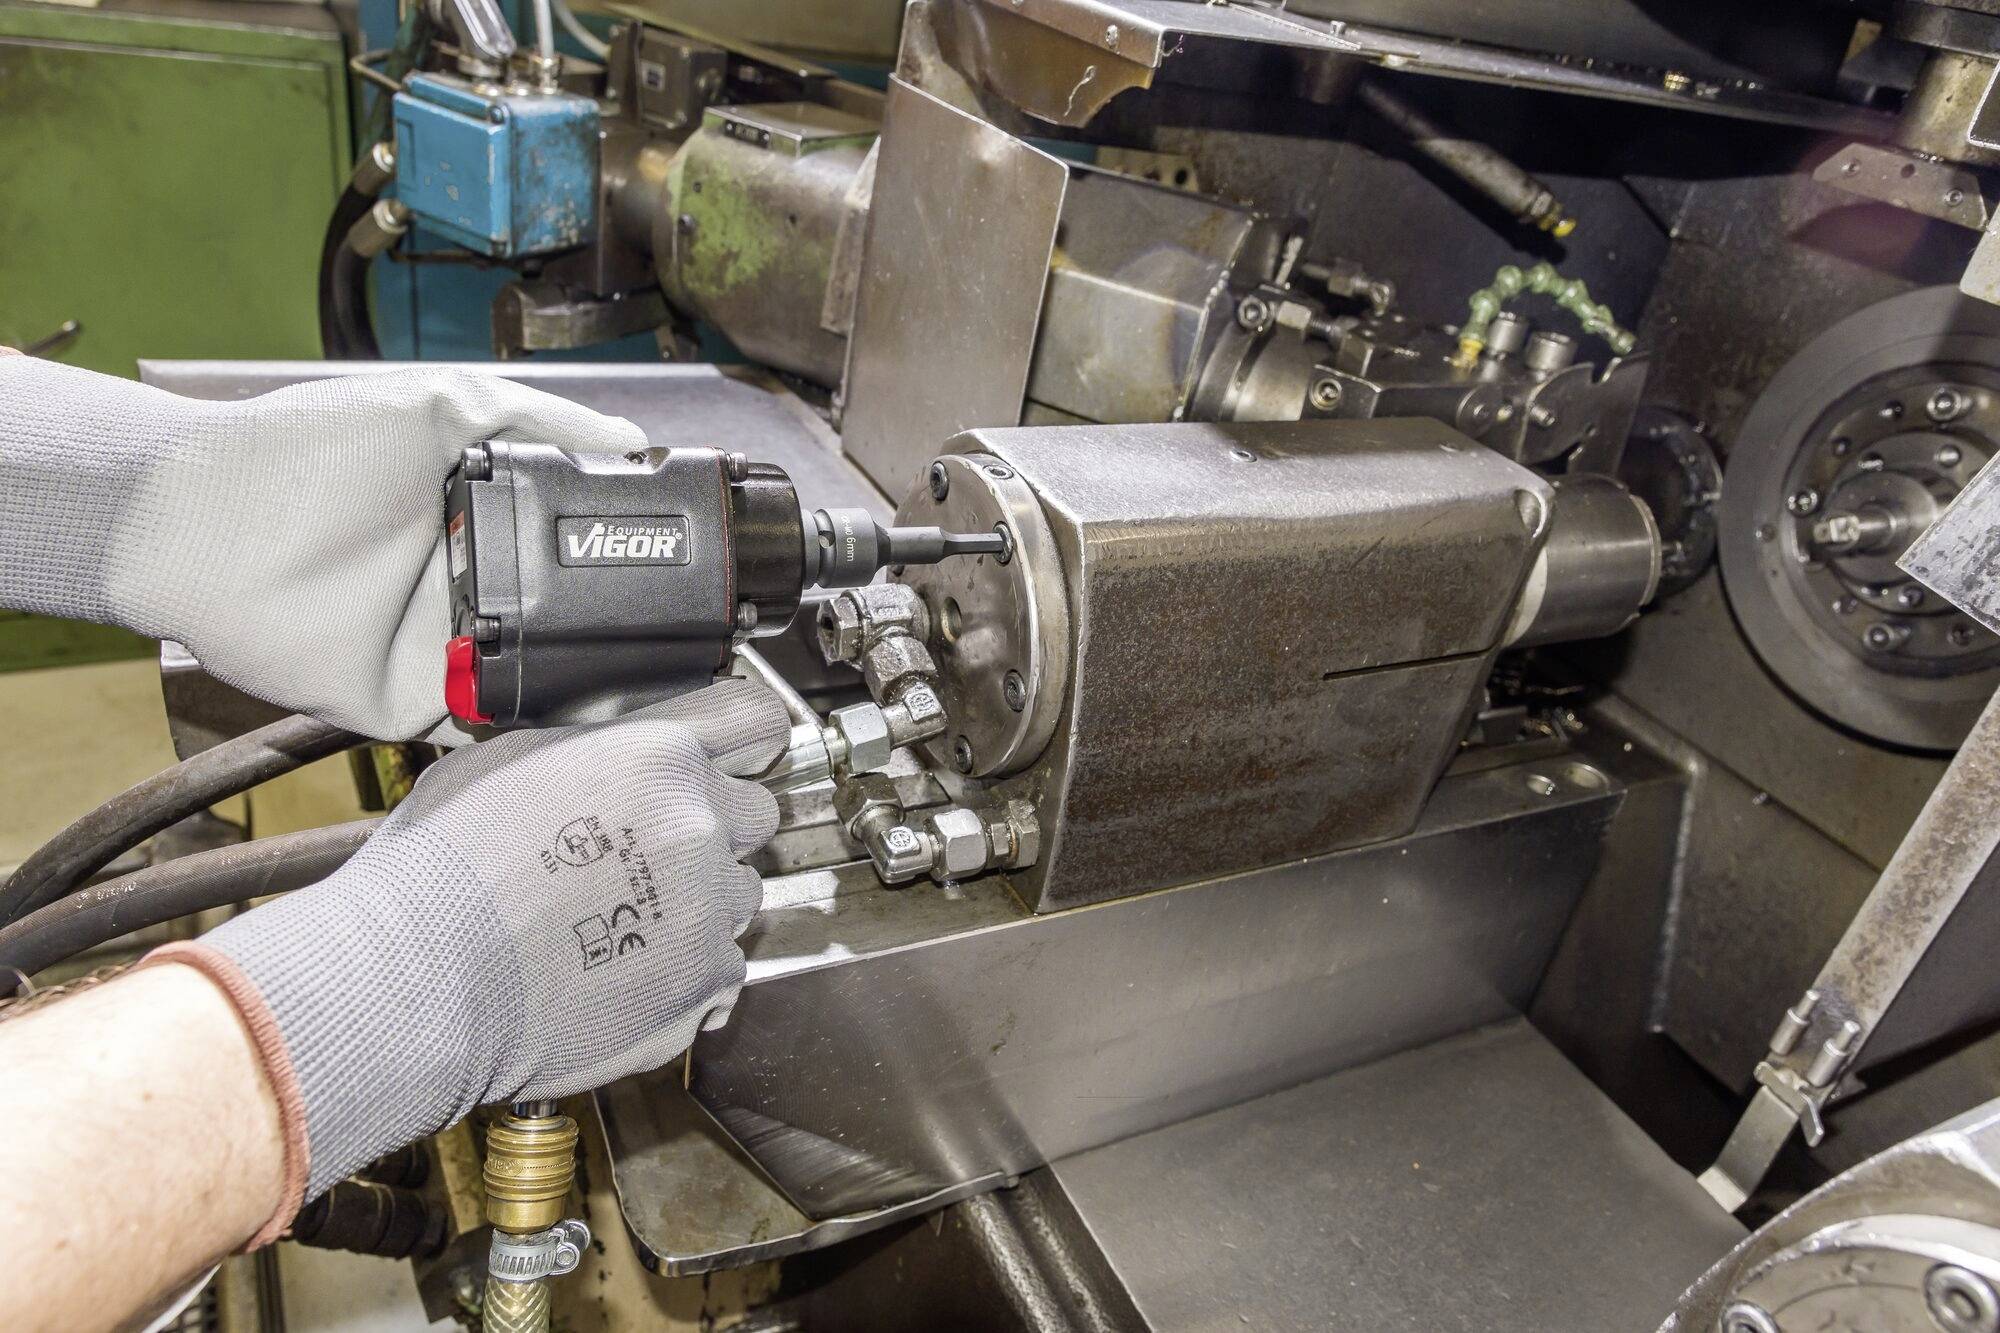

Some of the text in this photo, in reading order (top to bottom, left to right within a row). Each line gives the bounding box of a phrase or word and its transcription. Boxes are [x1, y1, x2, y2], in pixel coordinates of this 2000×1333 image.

[567, 522, 676, 558] VIGOR
[607, 525, 678, 536] EQUIPMENT
[846, 538, 856, 562] 6mm
[587, 815, 600, 831] EN
